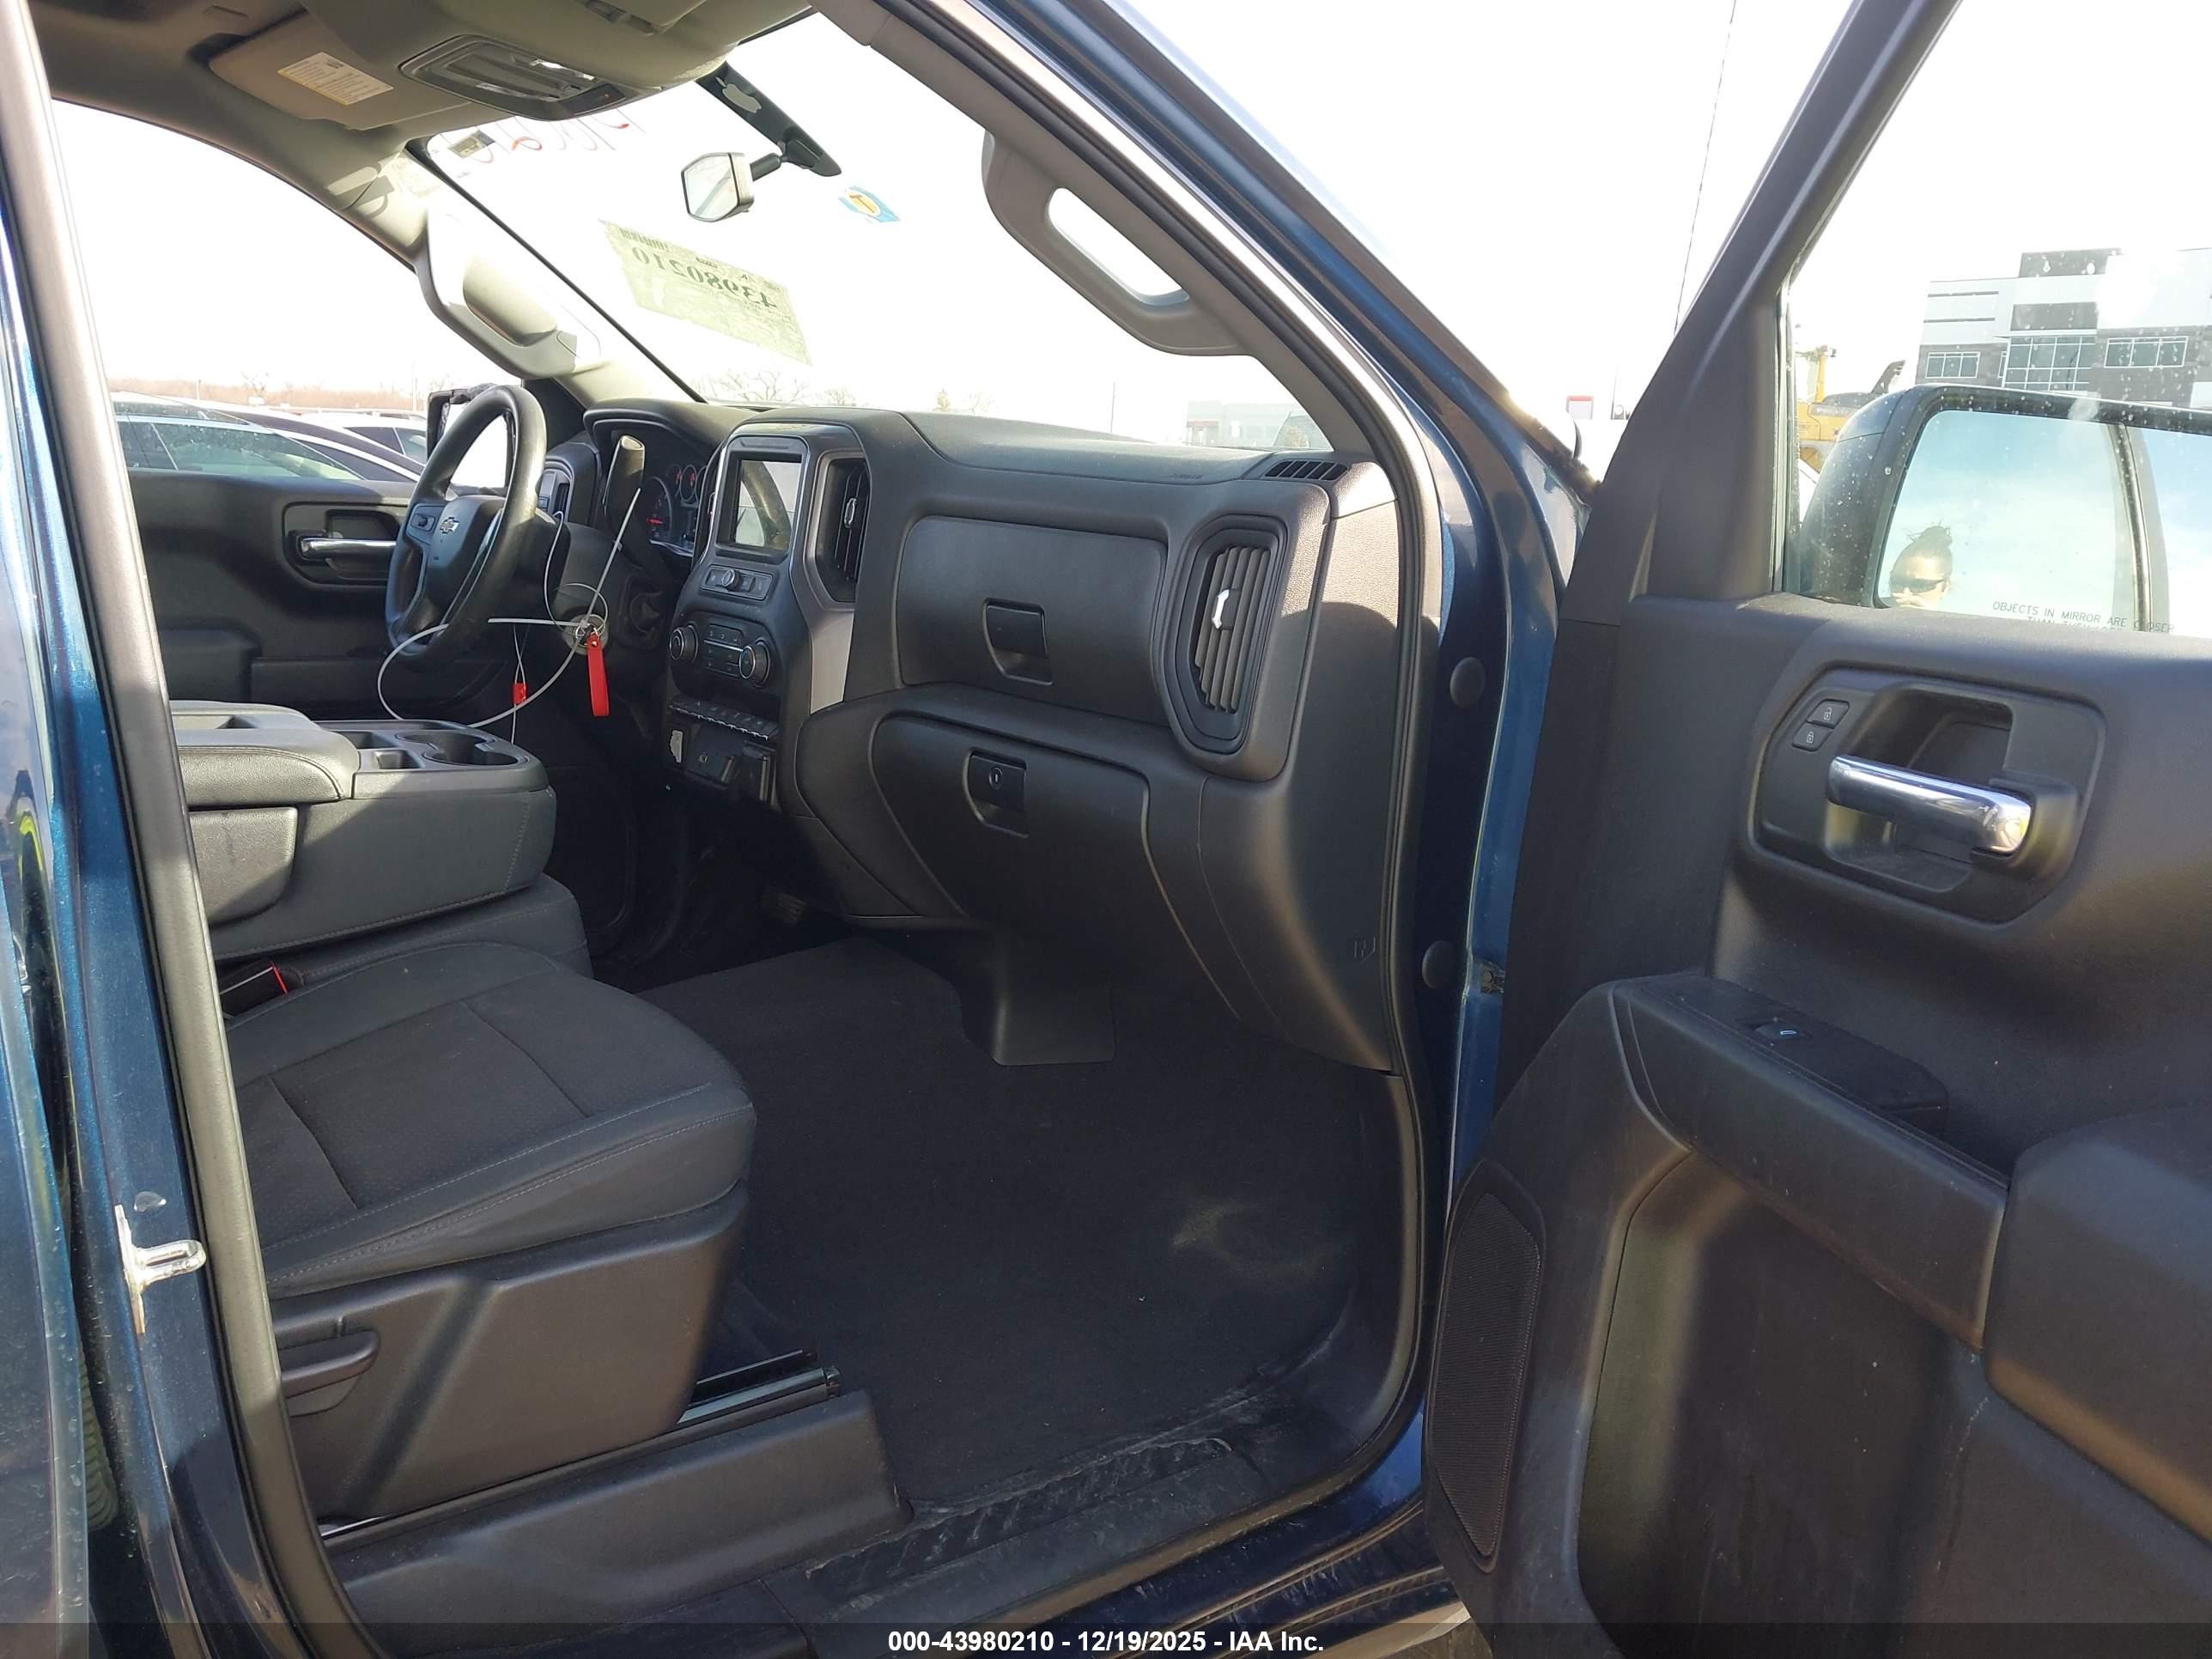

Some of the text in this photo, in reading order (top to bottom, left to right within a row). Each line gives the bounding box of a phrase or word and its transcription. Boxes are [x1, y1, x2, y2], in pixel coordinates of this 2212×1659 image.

[1992, 600, 2039, 616] OBJECTS
[2044, 607, 2055, 617] IN
[2061, 611, 2101, 623] MIRROR
[2107, 617, 2128, 627] ARE
[2133, 619, 2175, 633] COSER
